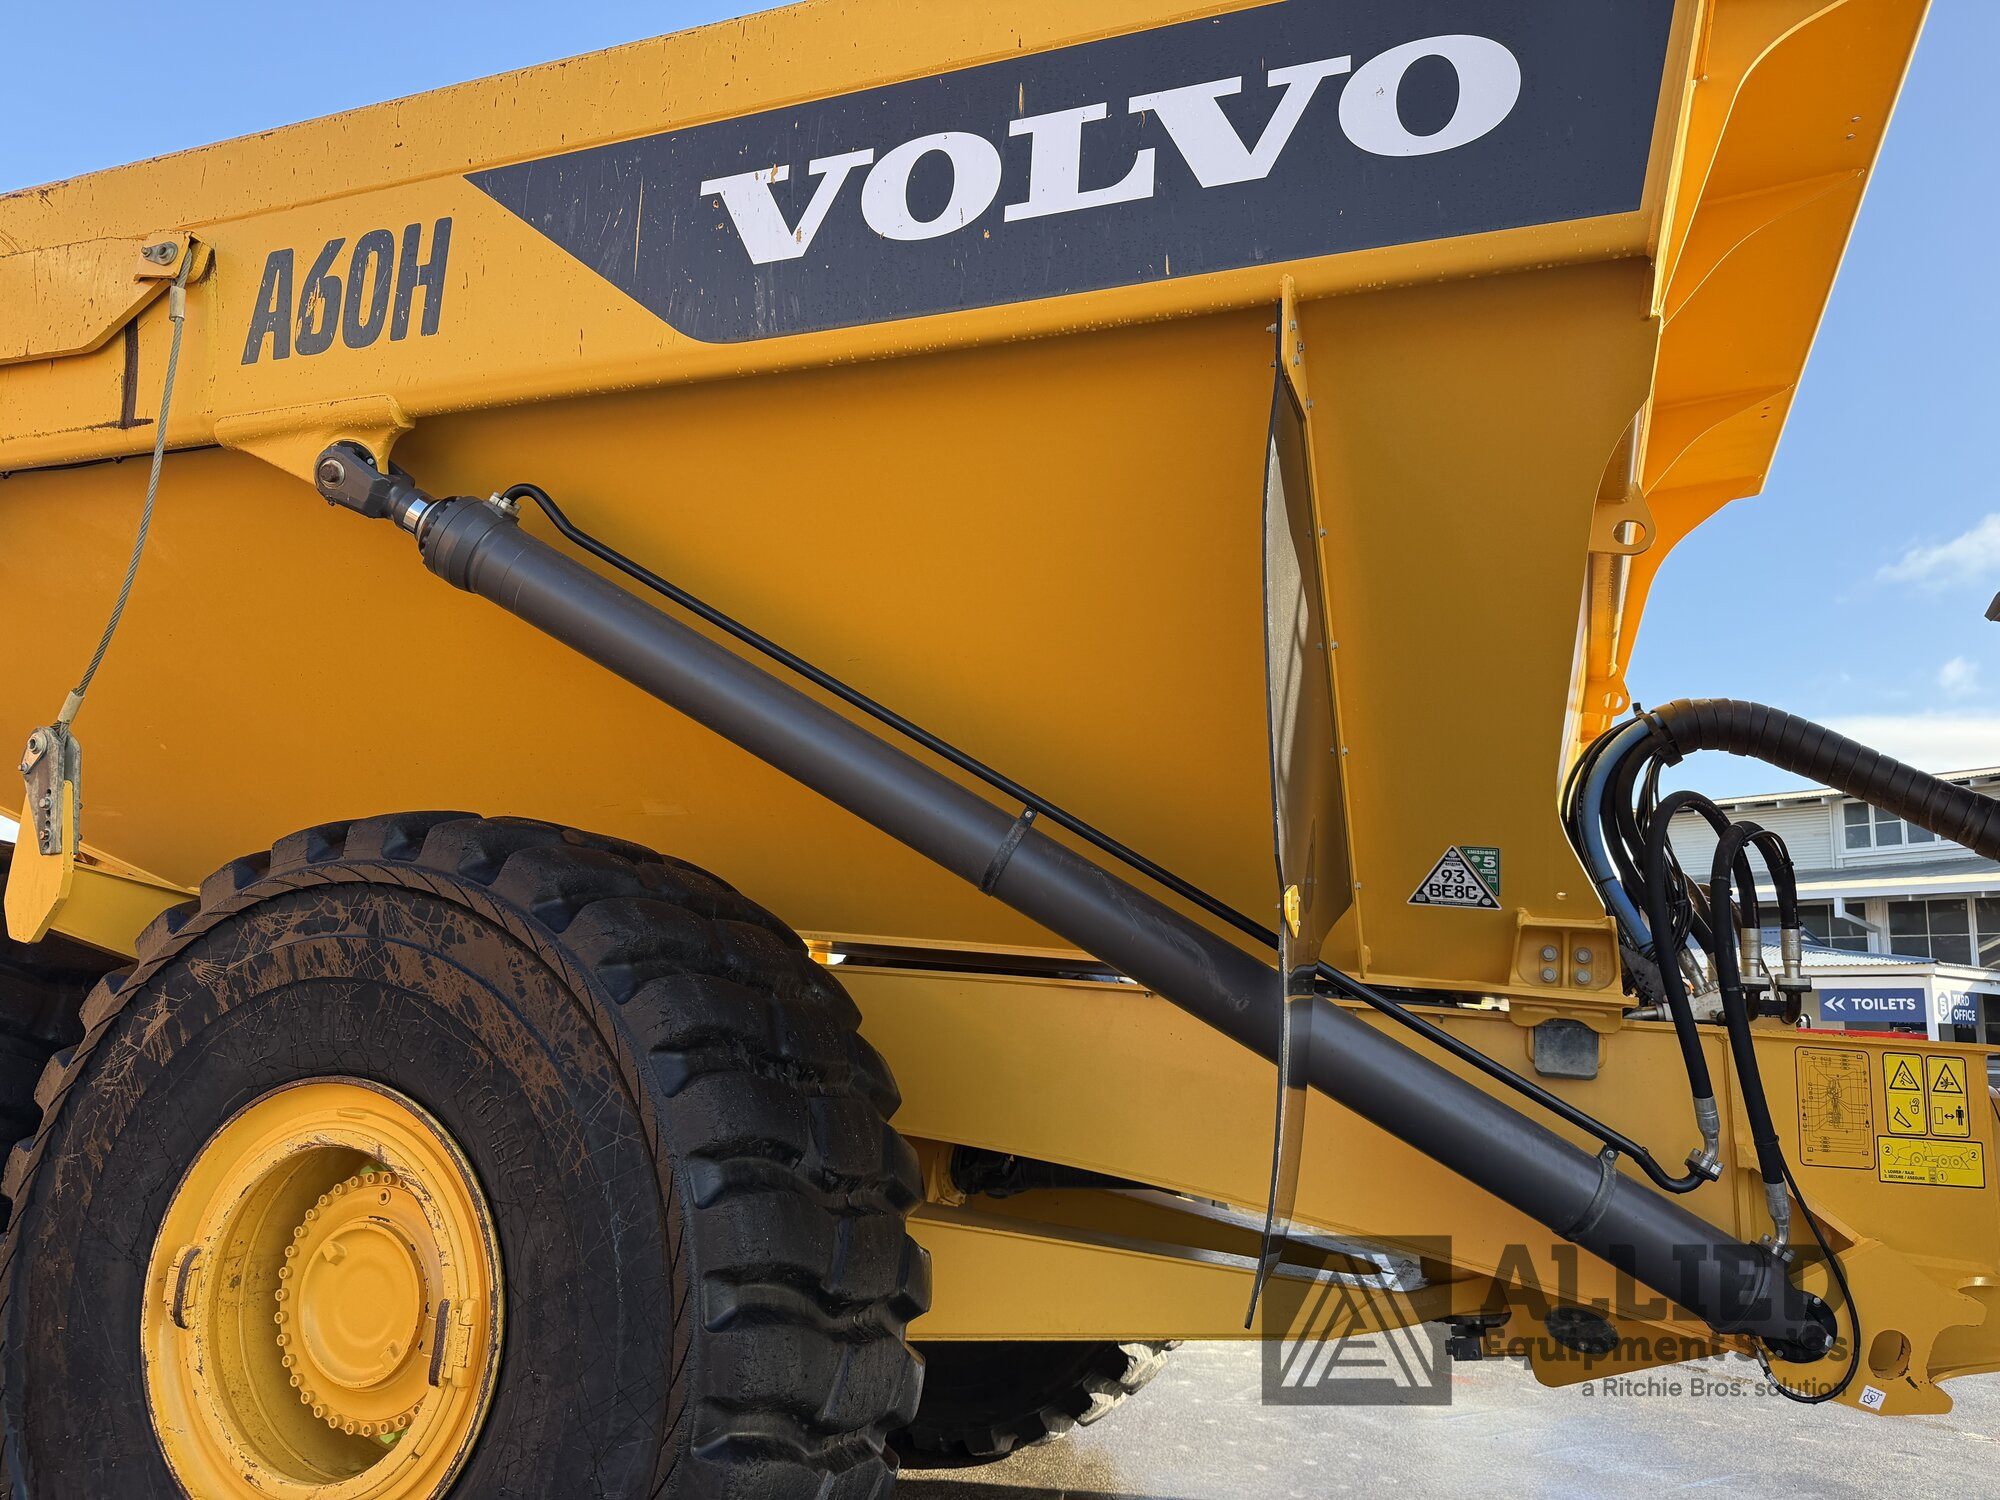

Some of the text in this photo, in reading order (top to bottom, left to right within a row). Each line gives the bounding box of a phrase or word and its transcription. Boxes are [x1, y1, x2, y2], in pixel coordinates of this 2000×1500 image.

[700, 34, 1522, 265] VOLVO
[241, 216, 453, 366] A60H
[1483, 856, 1496, 868] 5
[1441, 869, 1465, 884] 93
[1429, 884, 1478, 899] BE8C
[1851, 997, 1916, 1011] TOILETS
[1952, 994, 1970, 1006] YARD
[1953, 1008, 1976, 1021] OFFICE
